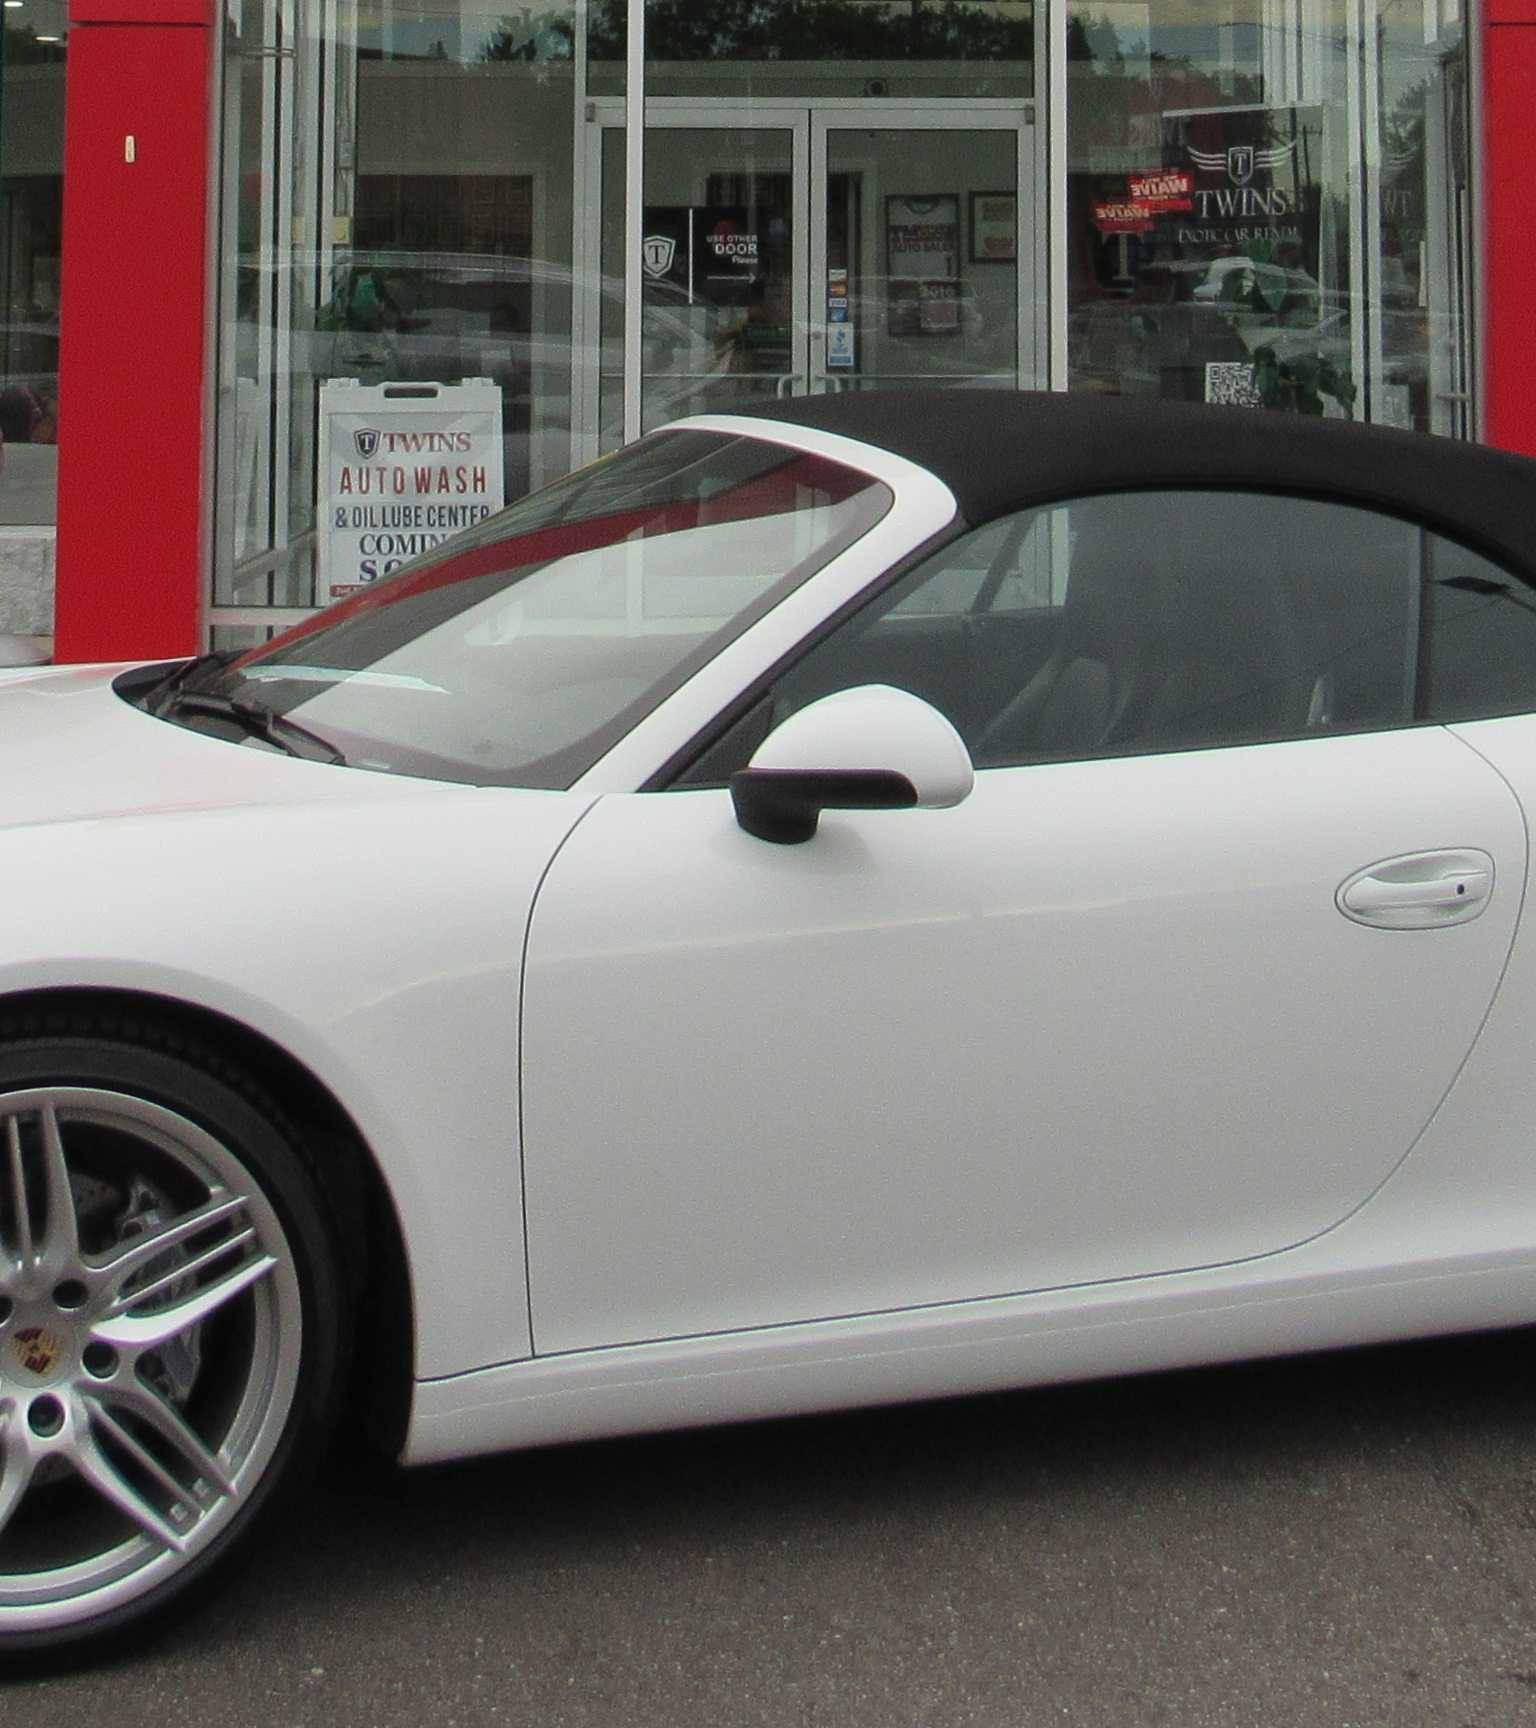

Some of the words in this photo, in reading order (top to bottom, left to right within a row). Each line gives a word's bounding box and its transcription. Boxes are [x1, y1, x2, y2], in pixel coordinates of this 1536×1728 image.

[1194, 186, 1287, 219] TWINS
[706, 234, 725, 243] USE
[726, 233, 758, 243] OTHER
[714, 243, 758, 255] DOOR
[381, 431, 472, 453] TWINS
[339, 466, 406, 495] AUTO
[414, 465, 487, 494] WASH
[335, 506, 348, 529] &
[351, 505, 379, 529] OIL
[381, 504, 424, 529] LUBE
[358, 532, 448, 556] COMIN
